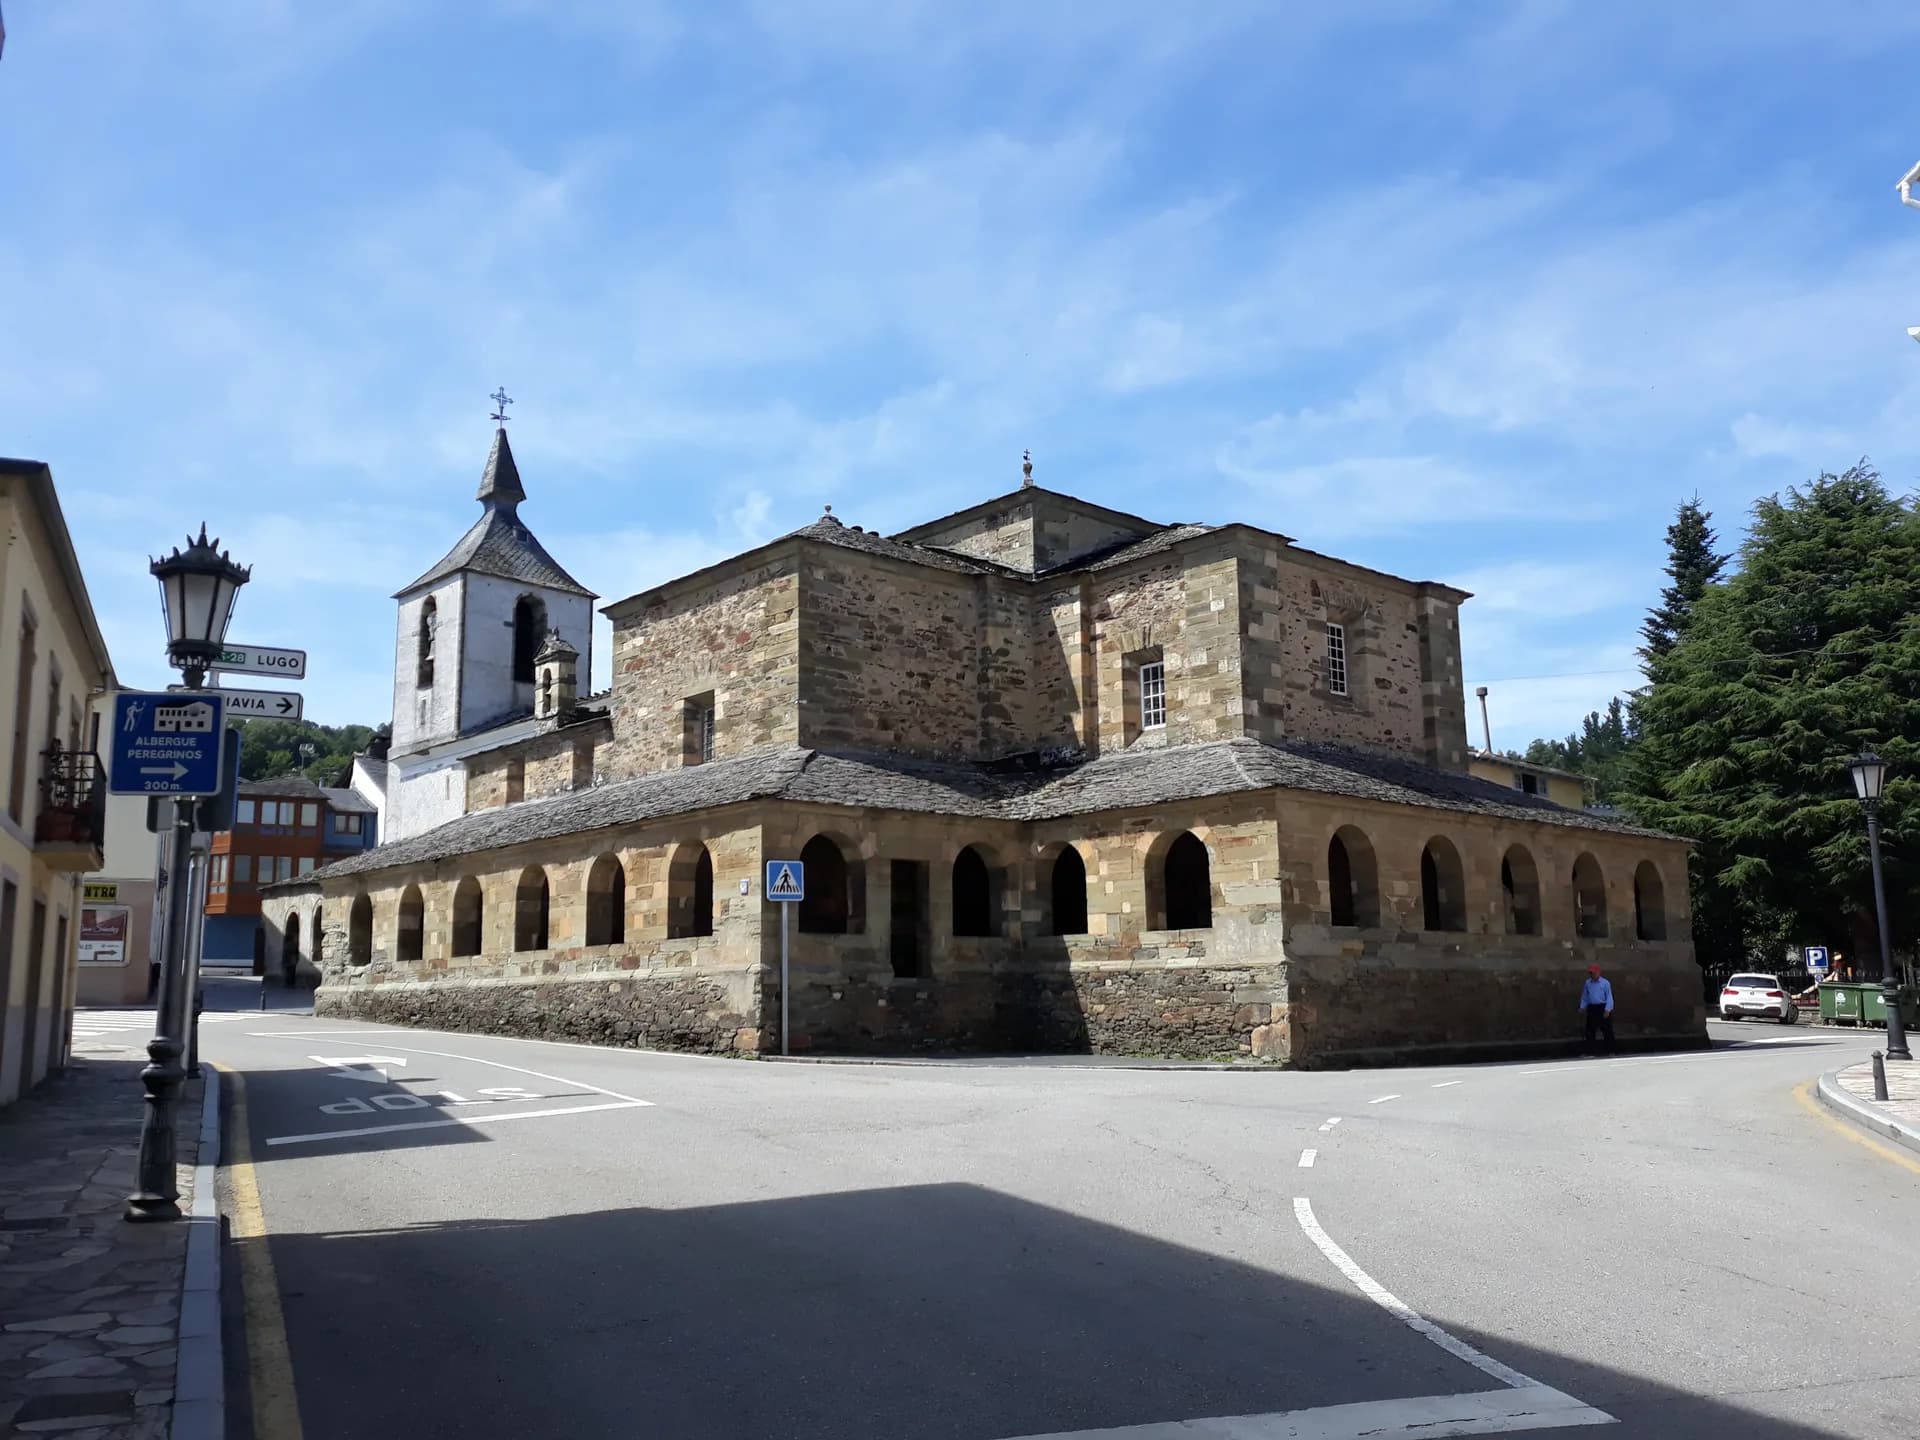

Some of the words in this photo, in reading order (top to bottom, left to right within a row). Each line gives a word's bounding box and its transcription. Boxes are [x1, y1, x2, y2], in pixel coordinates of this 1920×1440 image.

[257, 655, 299, 668] LUGO
[226, 697, 265, 710] AVIA
[135, 736, 197, 746] ALBERGUE
[127, 749, 203, 759] PEREGRINOS
[319, 1087, 543, 1114] STOP
